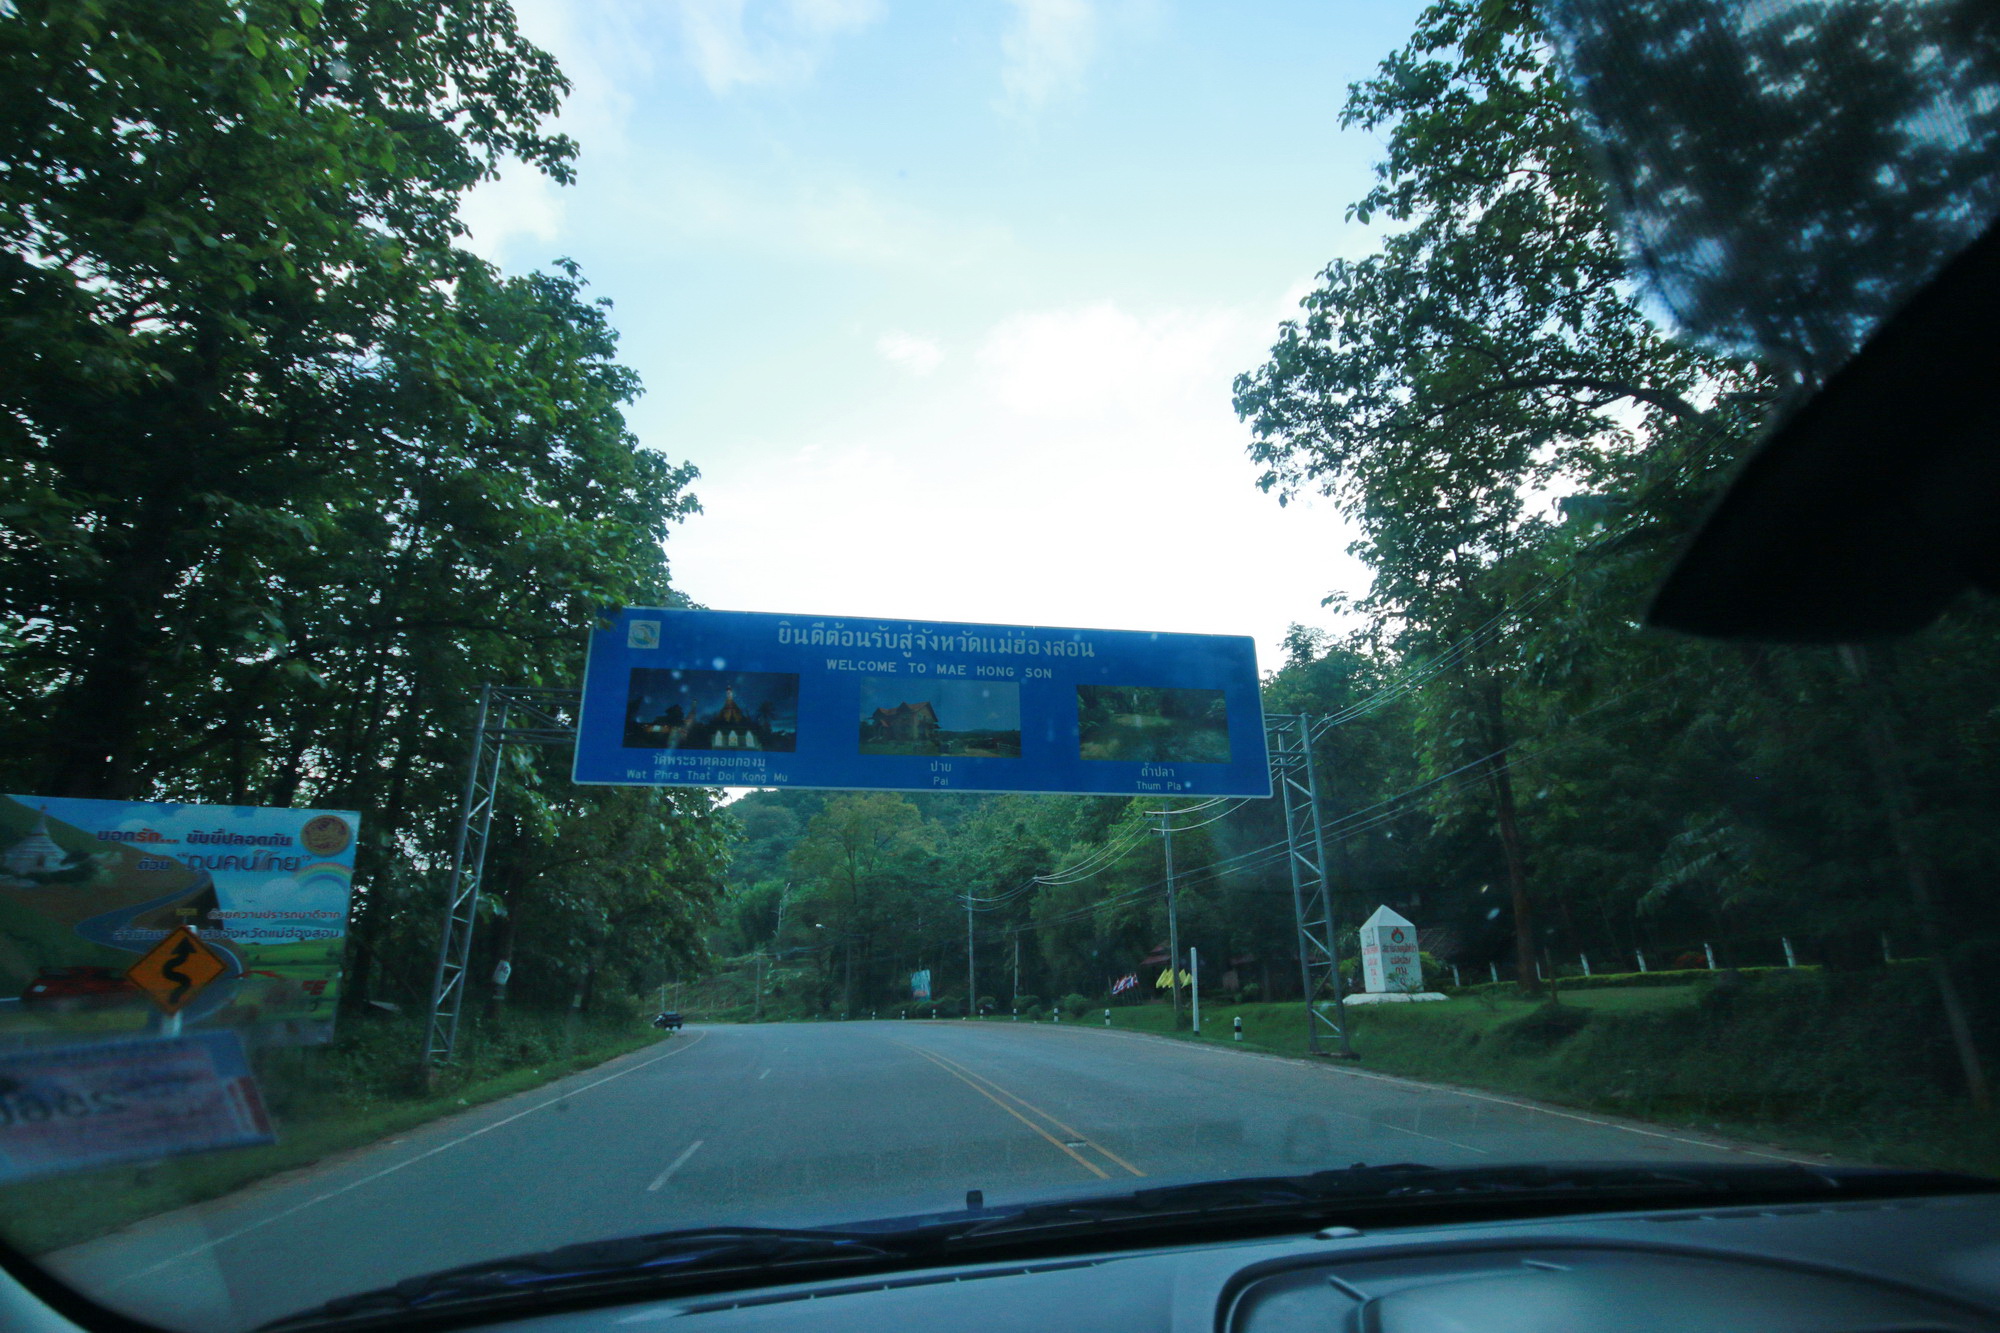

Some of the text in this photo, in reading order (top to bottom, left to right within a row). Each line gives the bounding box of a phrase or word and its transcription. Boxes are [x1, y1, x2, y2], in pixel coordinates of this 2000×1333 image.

[777, 620, 1096, 658] ยินดีต้อนรับสู่จังหวัดแม่ฮ่องสอน
[826, 658, 1053, 679] WELCOME TO MAE HONG SON
[653, 753, 766, 772] วัดพระธาตุดอยกองมู
[930, 760, 952, 773] ปาย
[1140, 762, 1175, 778] ถ้ำปลา
[626, 769, 788, 784] Wat Phra That Doi Kong Mu
[933, 776, 949, 786] Pai
[1136, 780, 1182, 791] Thum Pla
